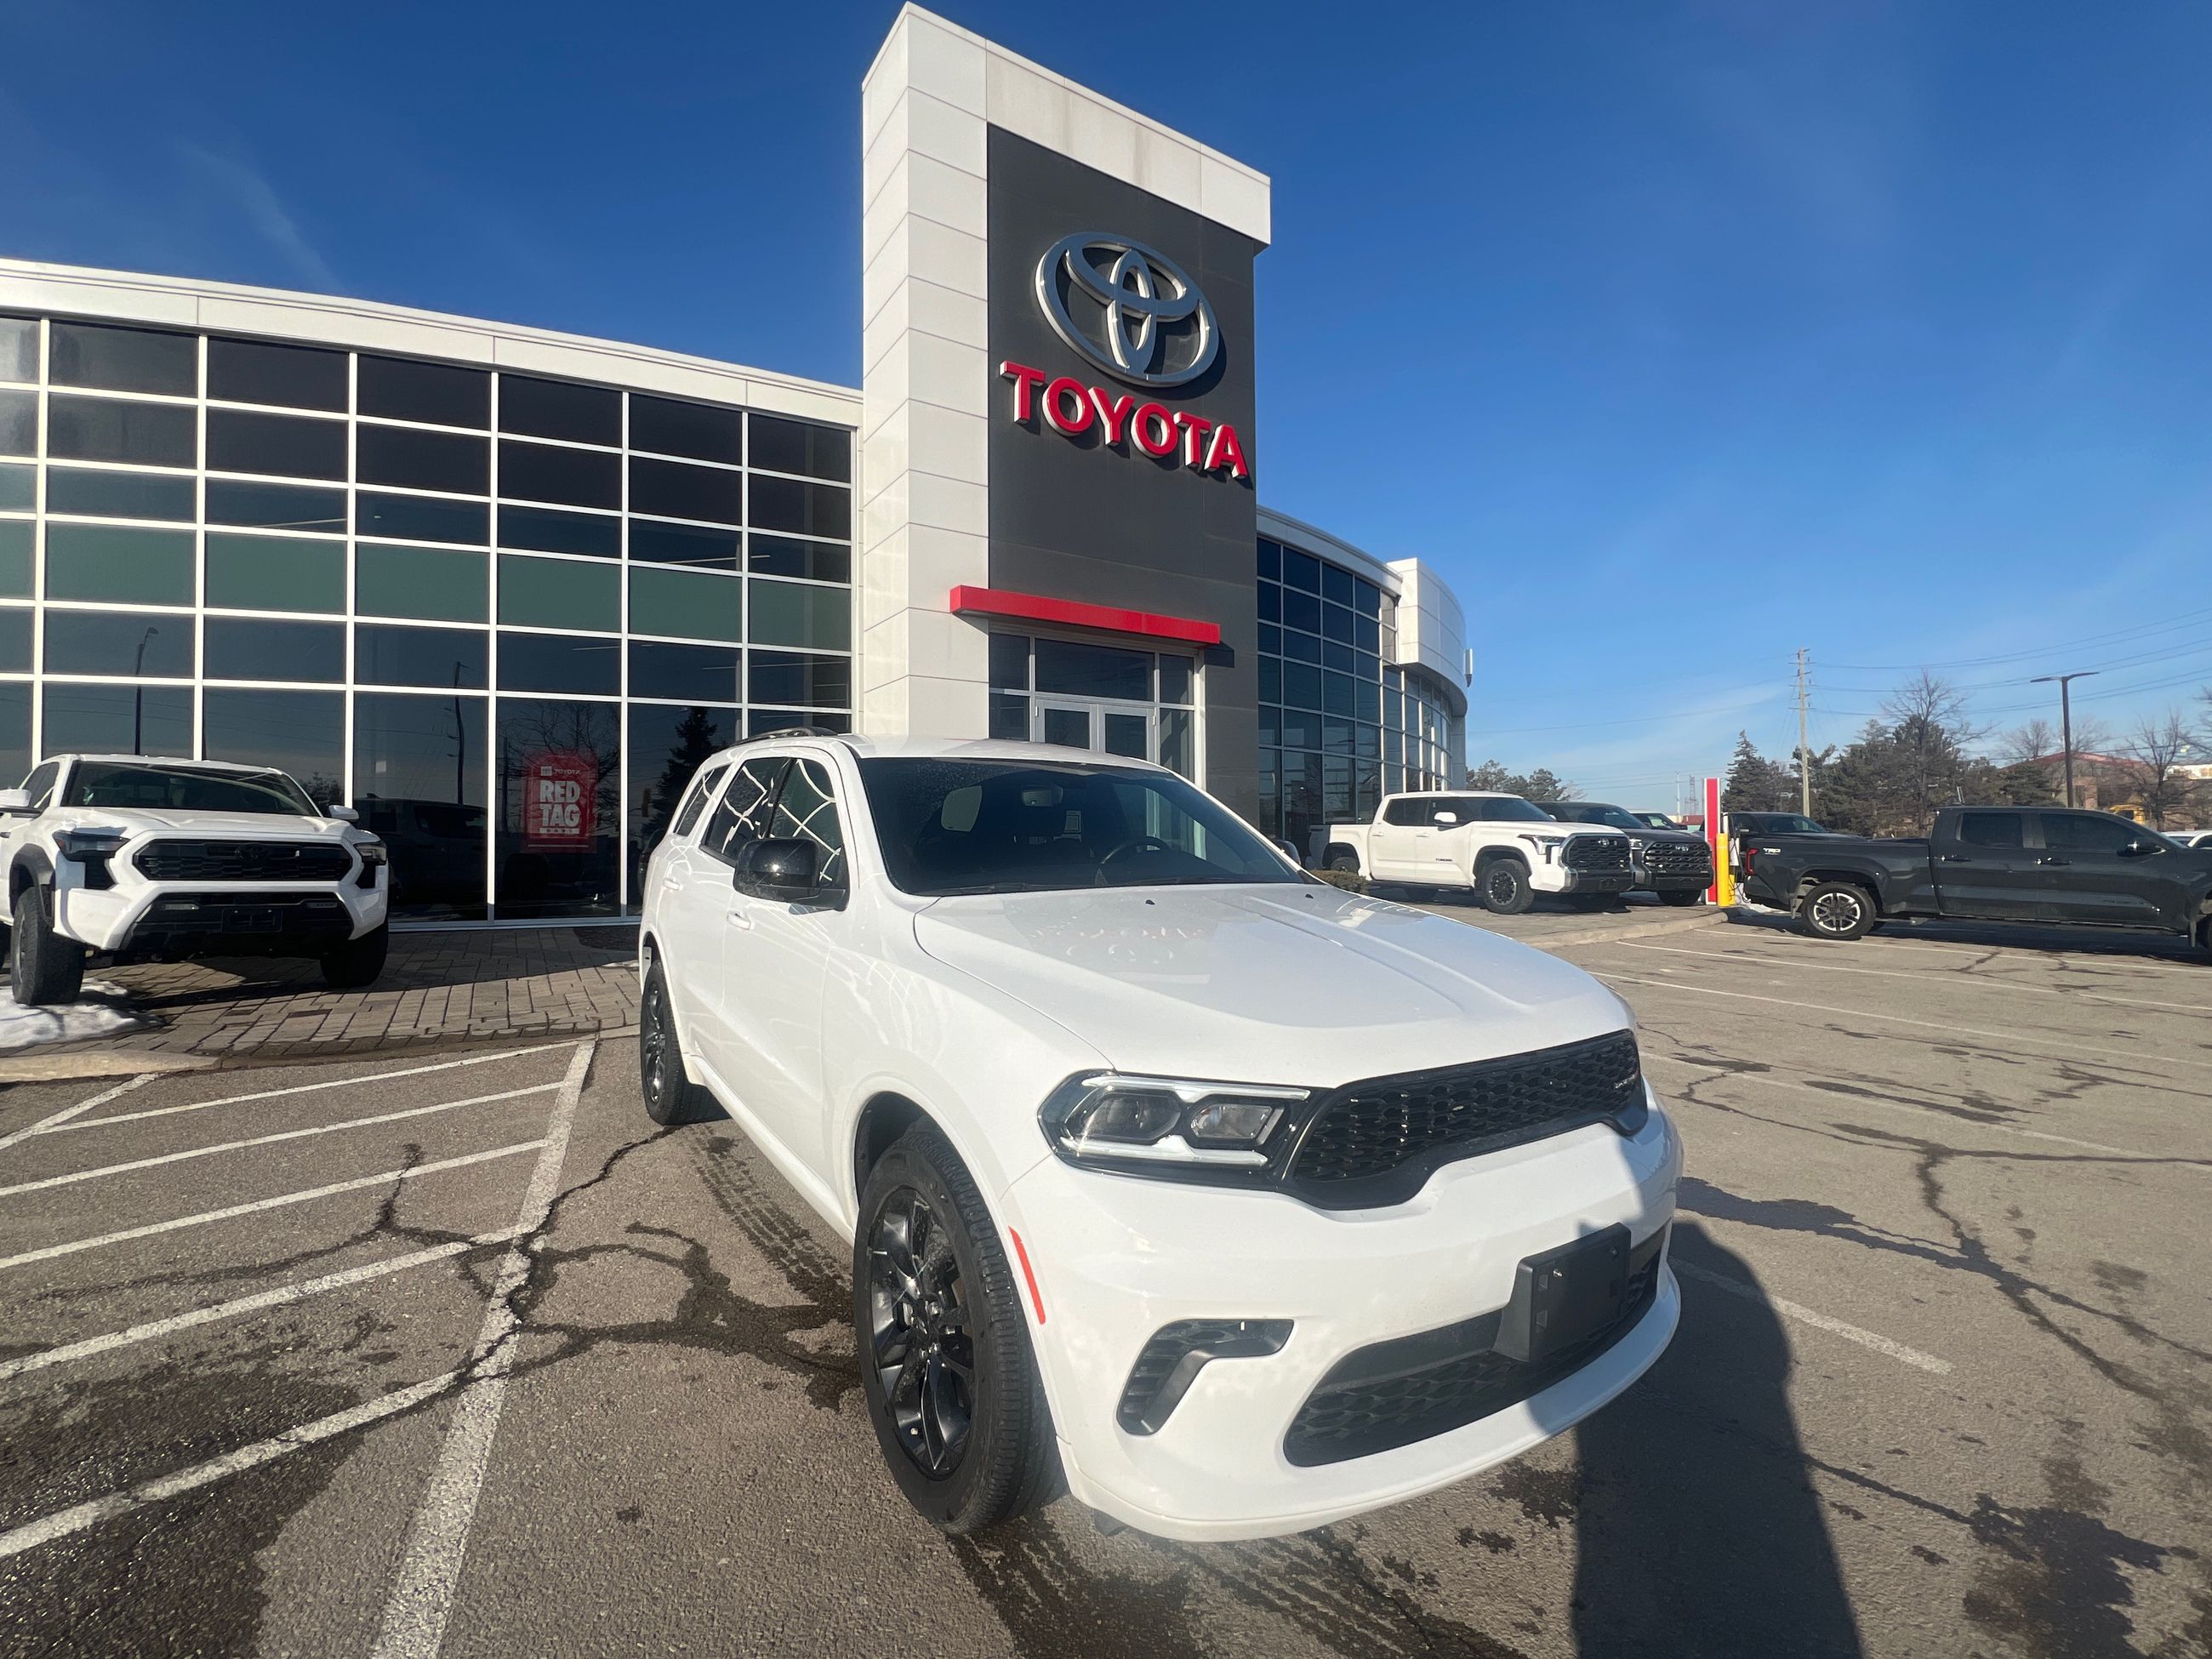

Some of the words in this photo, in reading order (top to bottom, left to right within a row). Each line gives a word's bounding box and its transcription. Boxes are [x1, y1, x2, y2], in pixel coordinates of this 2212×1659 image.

[1000, 361, 1248, 479] TOYOTA
[539, 779, 580, 802] RED
[539, 803, 580, 827] TAG
